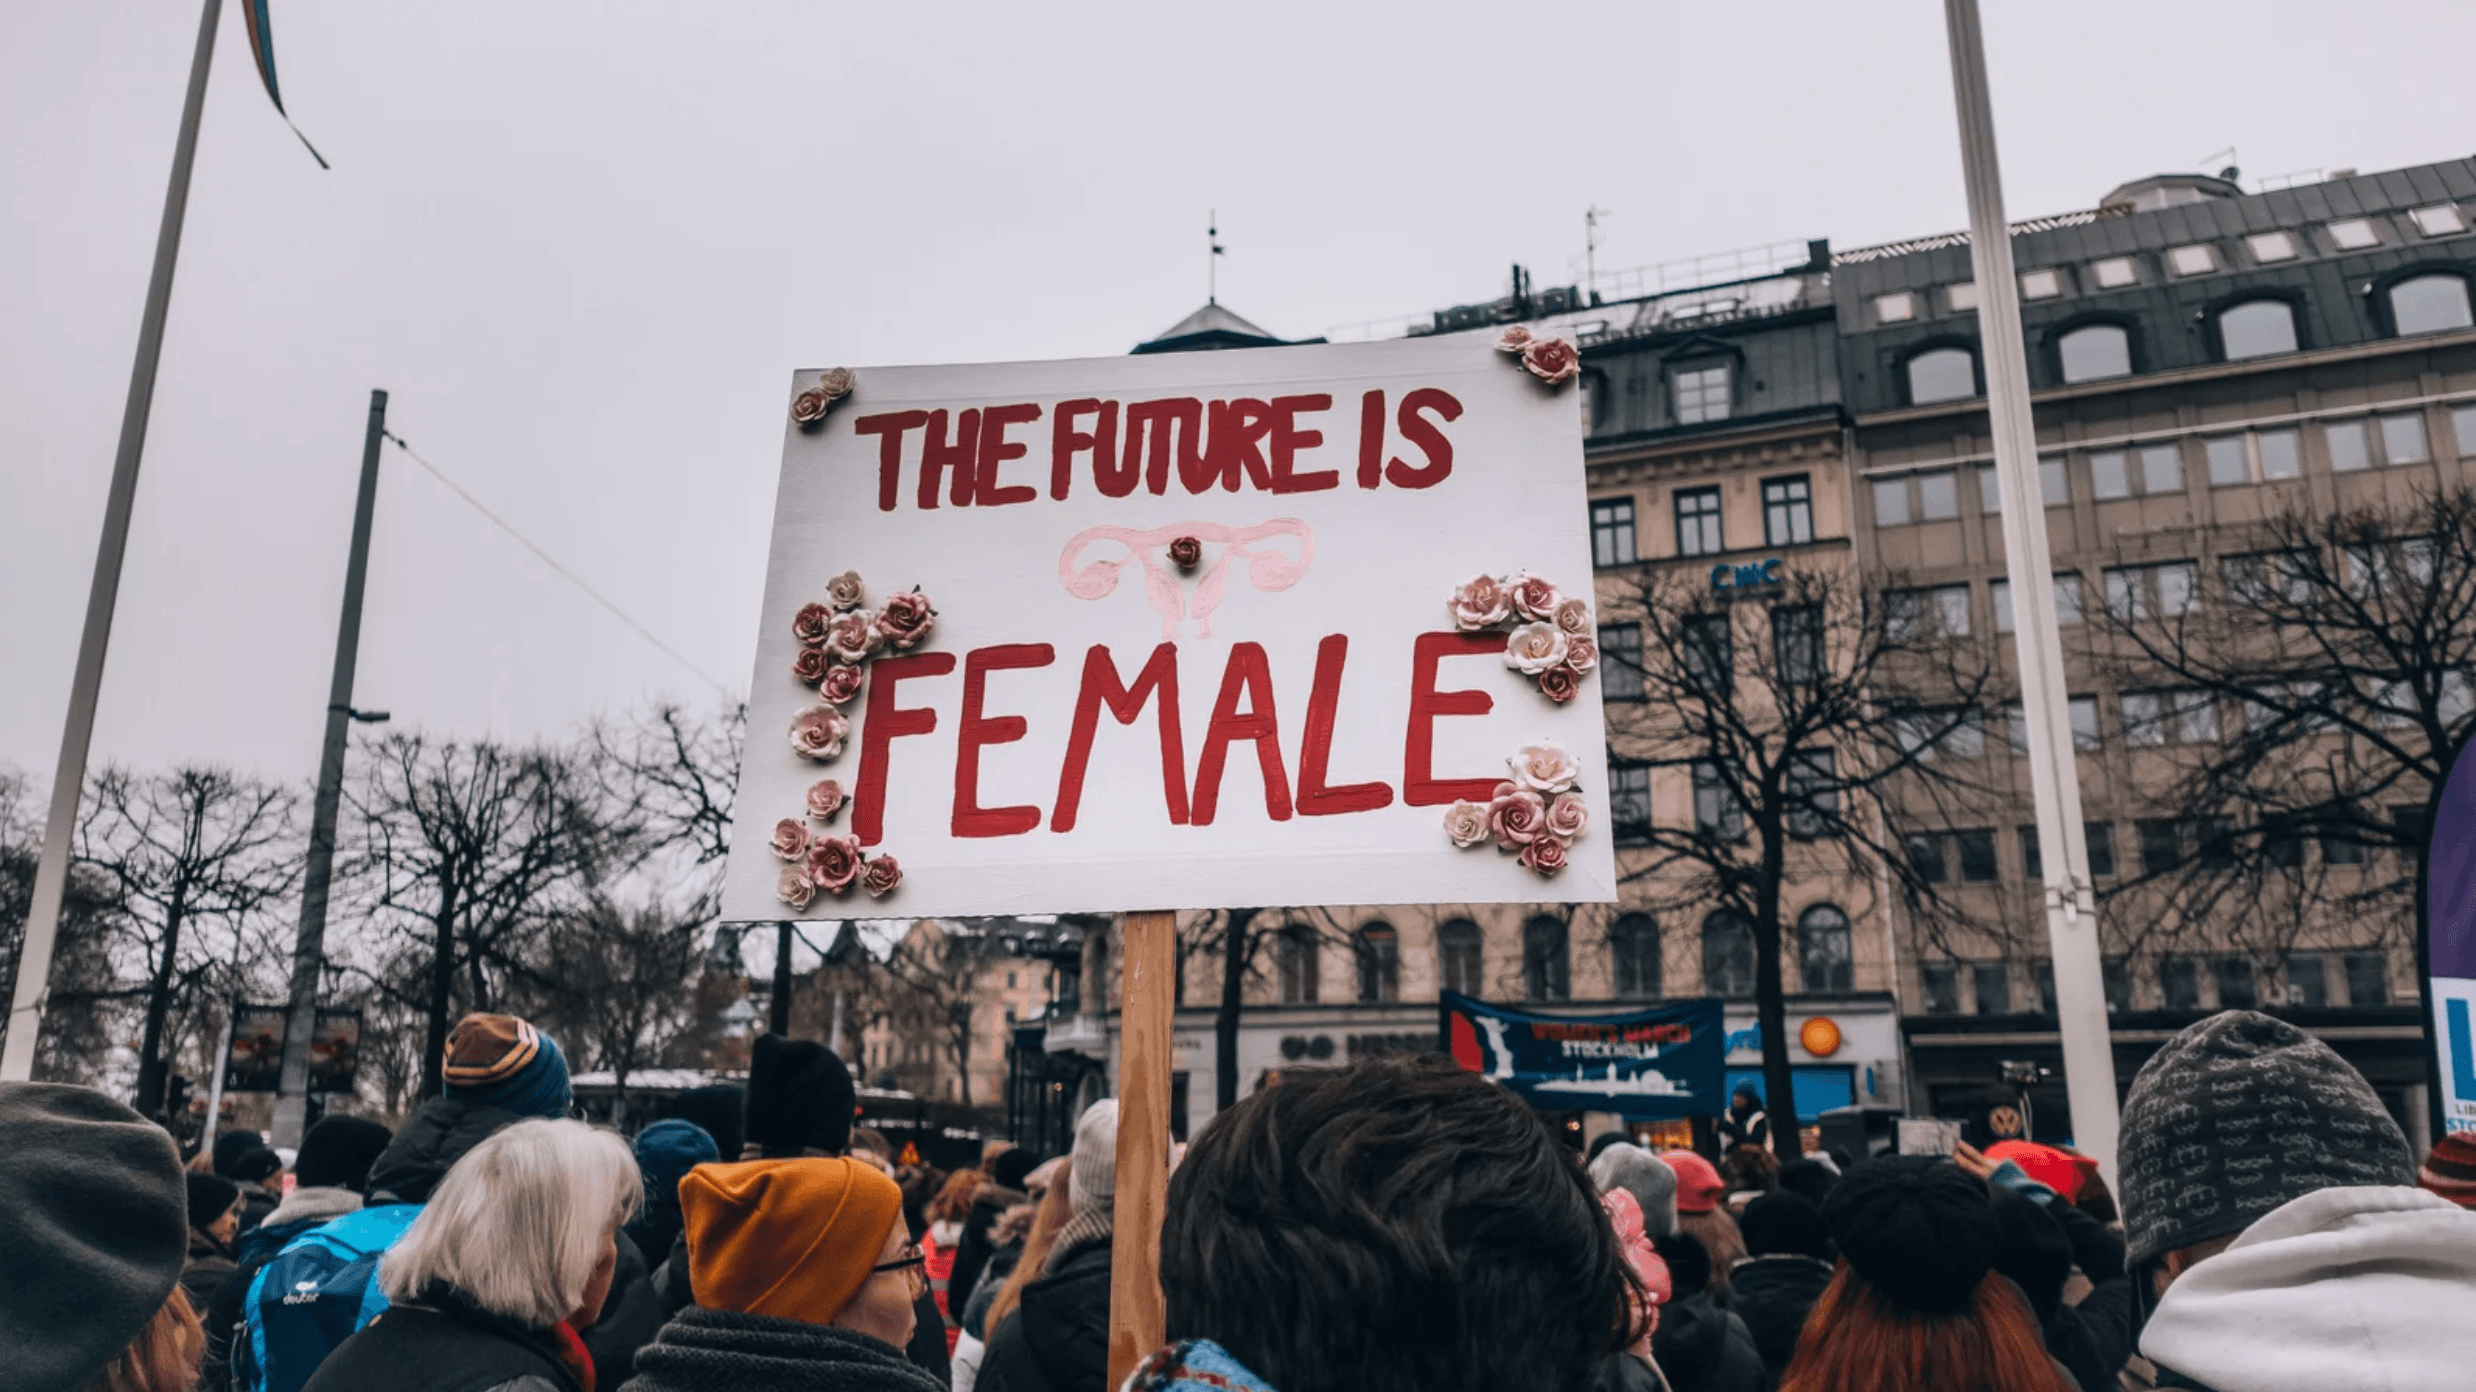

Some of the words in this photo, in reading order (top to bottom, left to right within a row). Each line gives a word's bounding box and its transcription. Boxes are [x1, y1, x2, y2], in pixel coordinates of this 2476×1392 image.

[855, 403, 1042, 512] THE
[1050, 394, 1339, 501] FUTURE
[1357, 388, 1463, 489] IS
[850, 632, 1515, 846] FEMALE
[1562, 1040, 1659, 1060] STOCKHOLM
[283, 1289, 320, 1305] deuter
